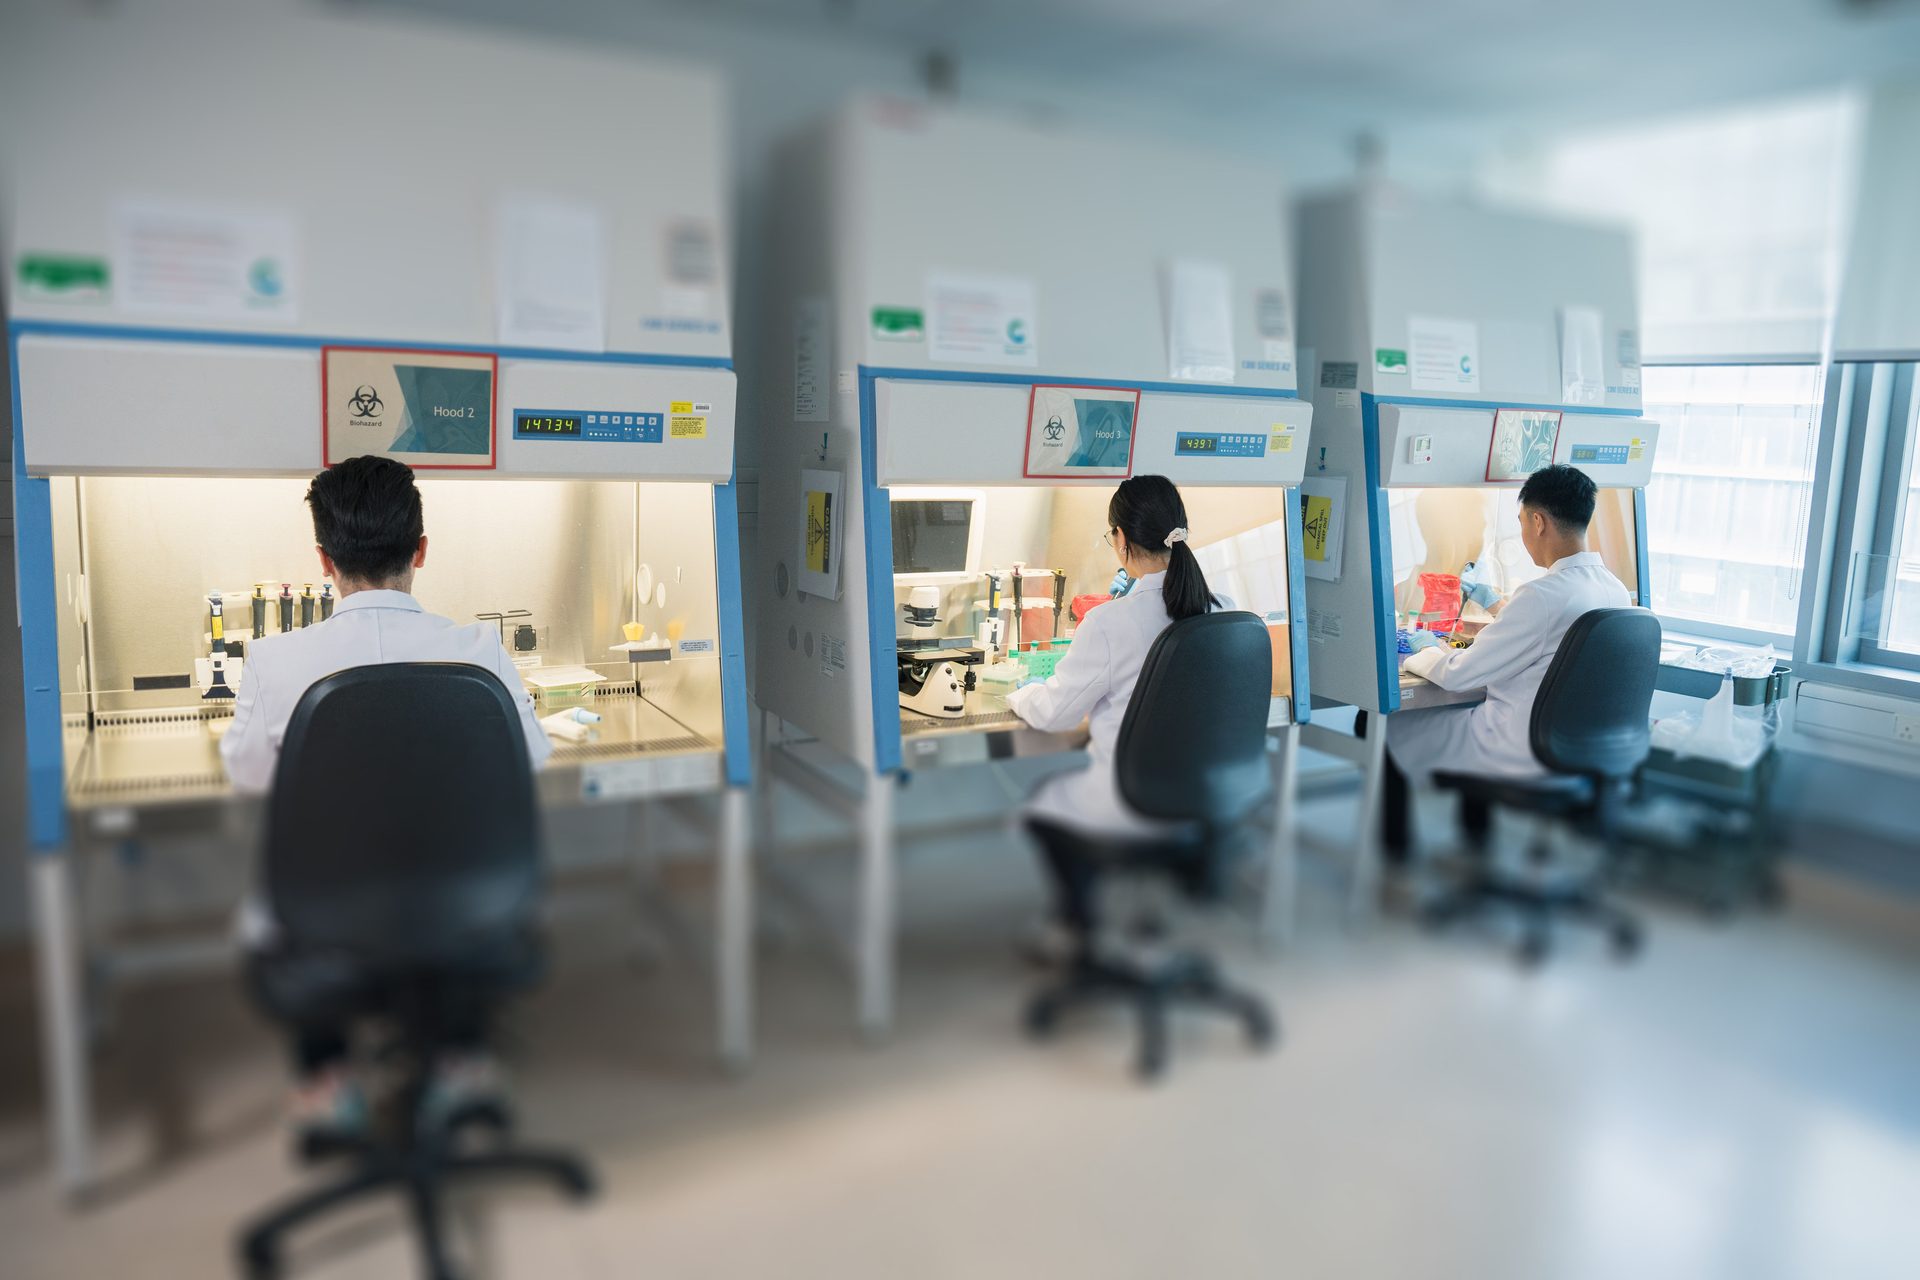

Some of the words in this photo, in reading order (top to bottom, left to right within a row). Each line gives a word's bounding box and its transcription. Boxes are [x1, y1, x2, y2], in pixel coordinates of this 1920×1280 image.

[434, 406, 463, 417] Hood
[468, 407, 474, 418] 2
[525, 419, 573, 431] 14734
[1095, 430, 1114, 439] Hood
[1116, 430, 1121, 439] 3
[1187, 439, 1212, 449] 4397
